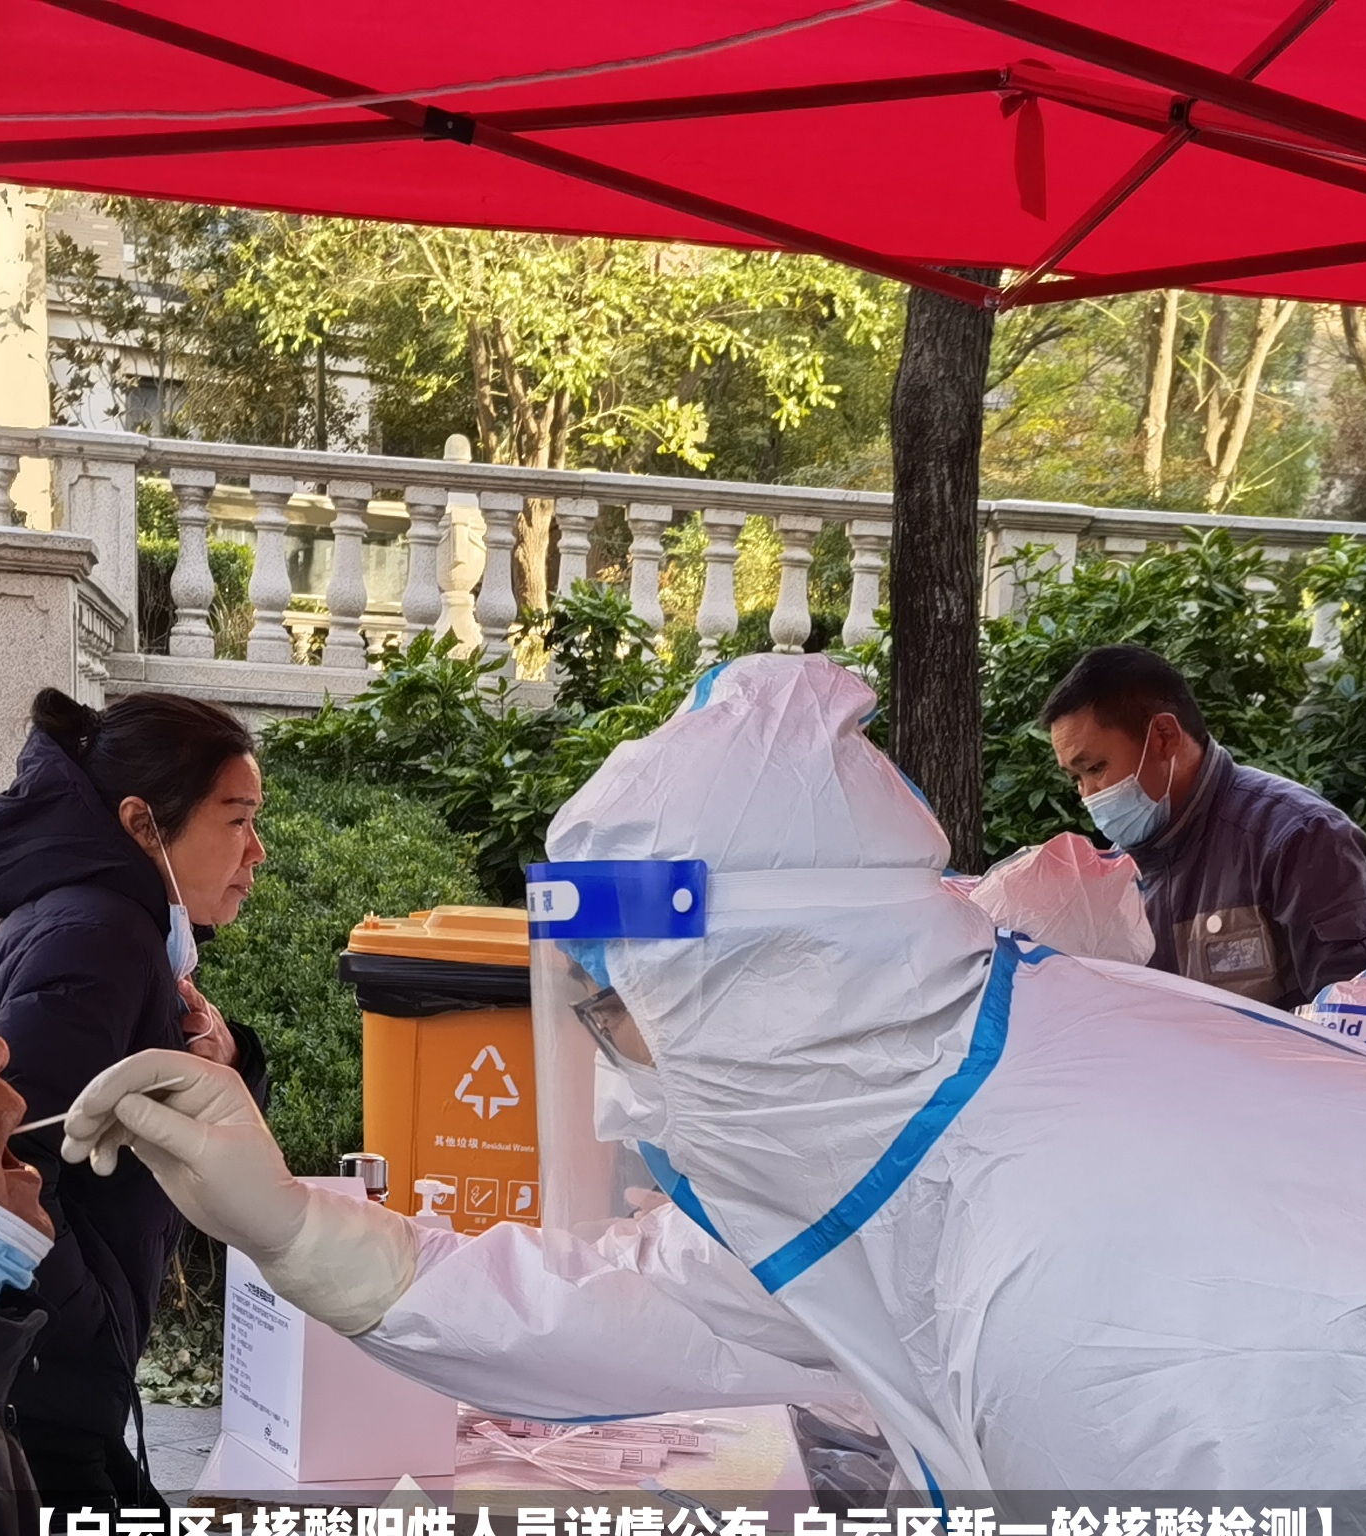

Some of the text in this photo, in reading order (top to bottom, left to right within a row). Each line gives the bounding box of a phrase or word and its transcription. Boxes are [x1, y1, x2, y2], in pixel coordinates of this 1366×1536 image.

[434, 1135, 479, 1149] 其他垃圾
[481, 1141, 512, 1151] Residual
